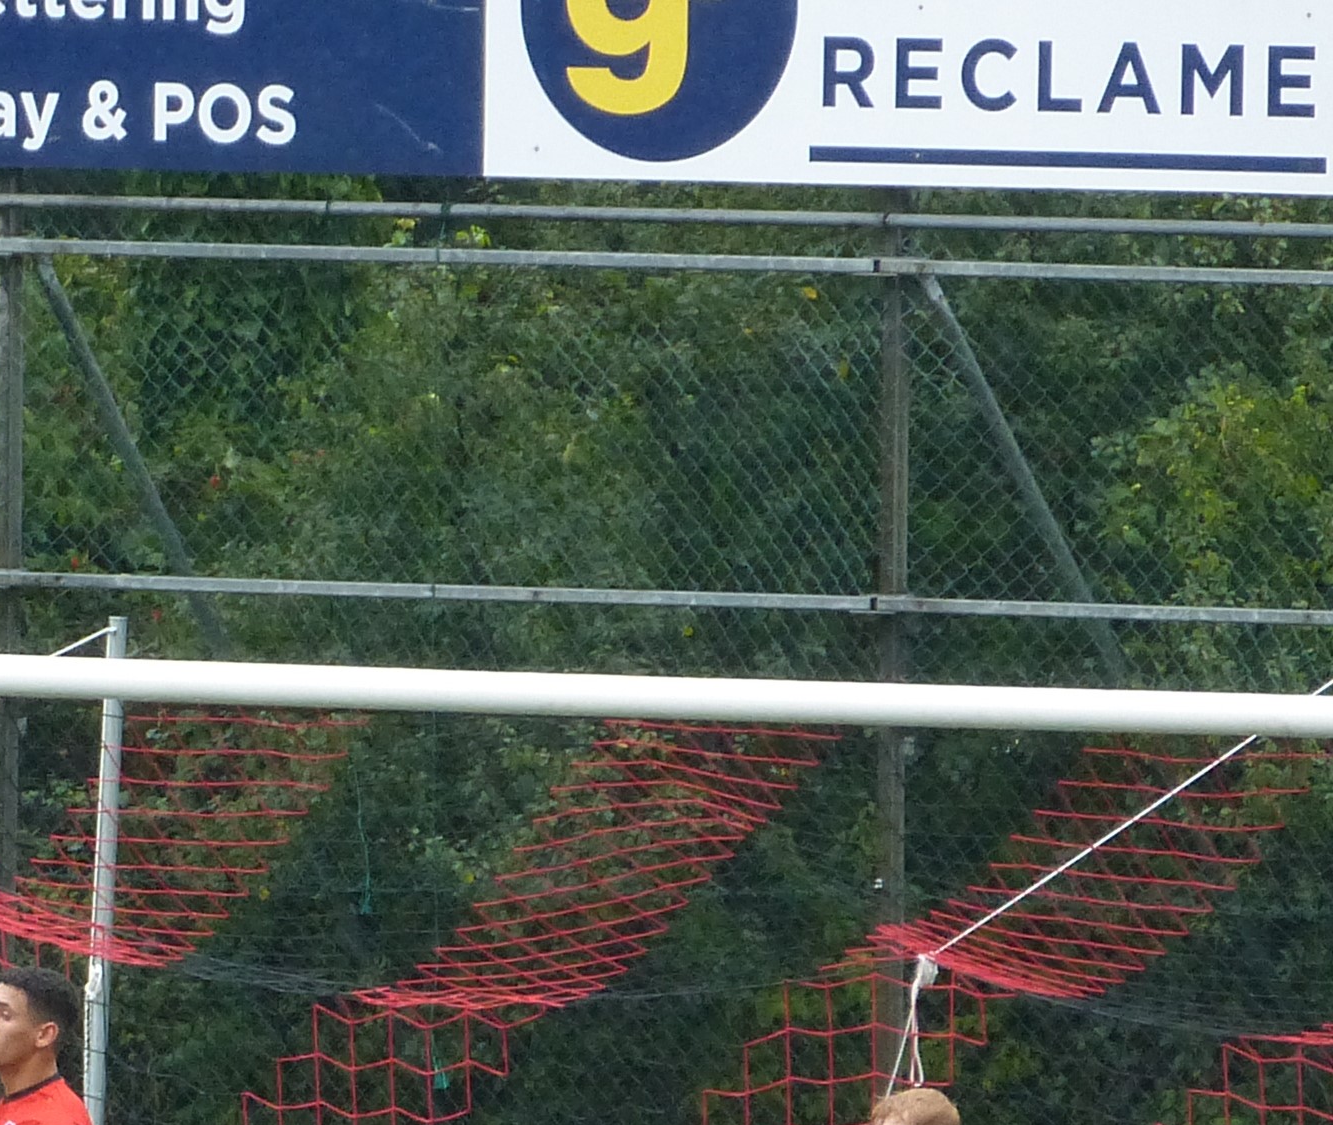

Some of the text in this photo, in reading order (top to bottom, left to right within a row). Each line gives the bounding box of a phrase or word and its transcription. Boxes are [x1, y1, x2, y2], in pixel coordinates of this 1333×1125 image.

[81, 79, 129, 142] &
[153, 81, 298, 147] POS
[821, 35, 1317, 119] RECLAME
